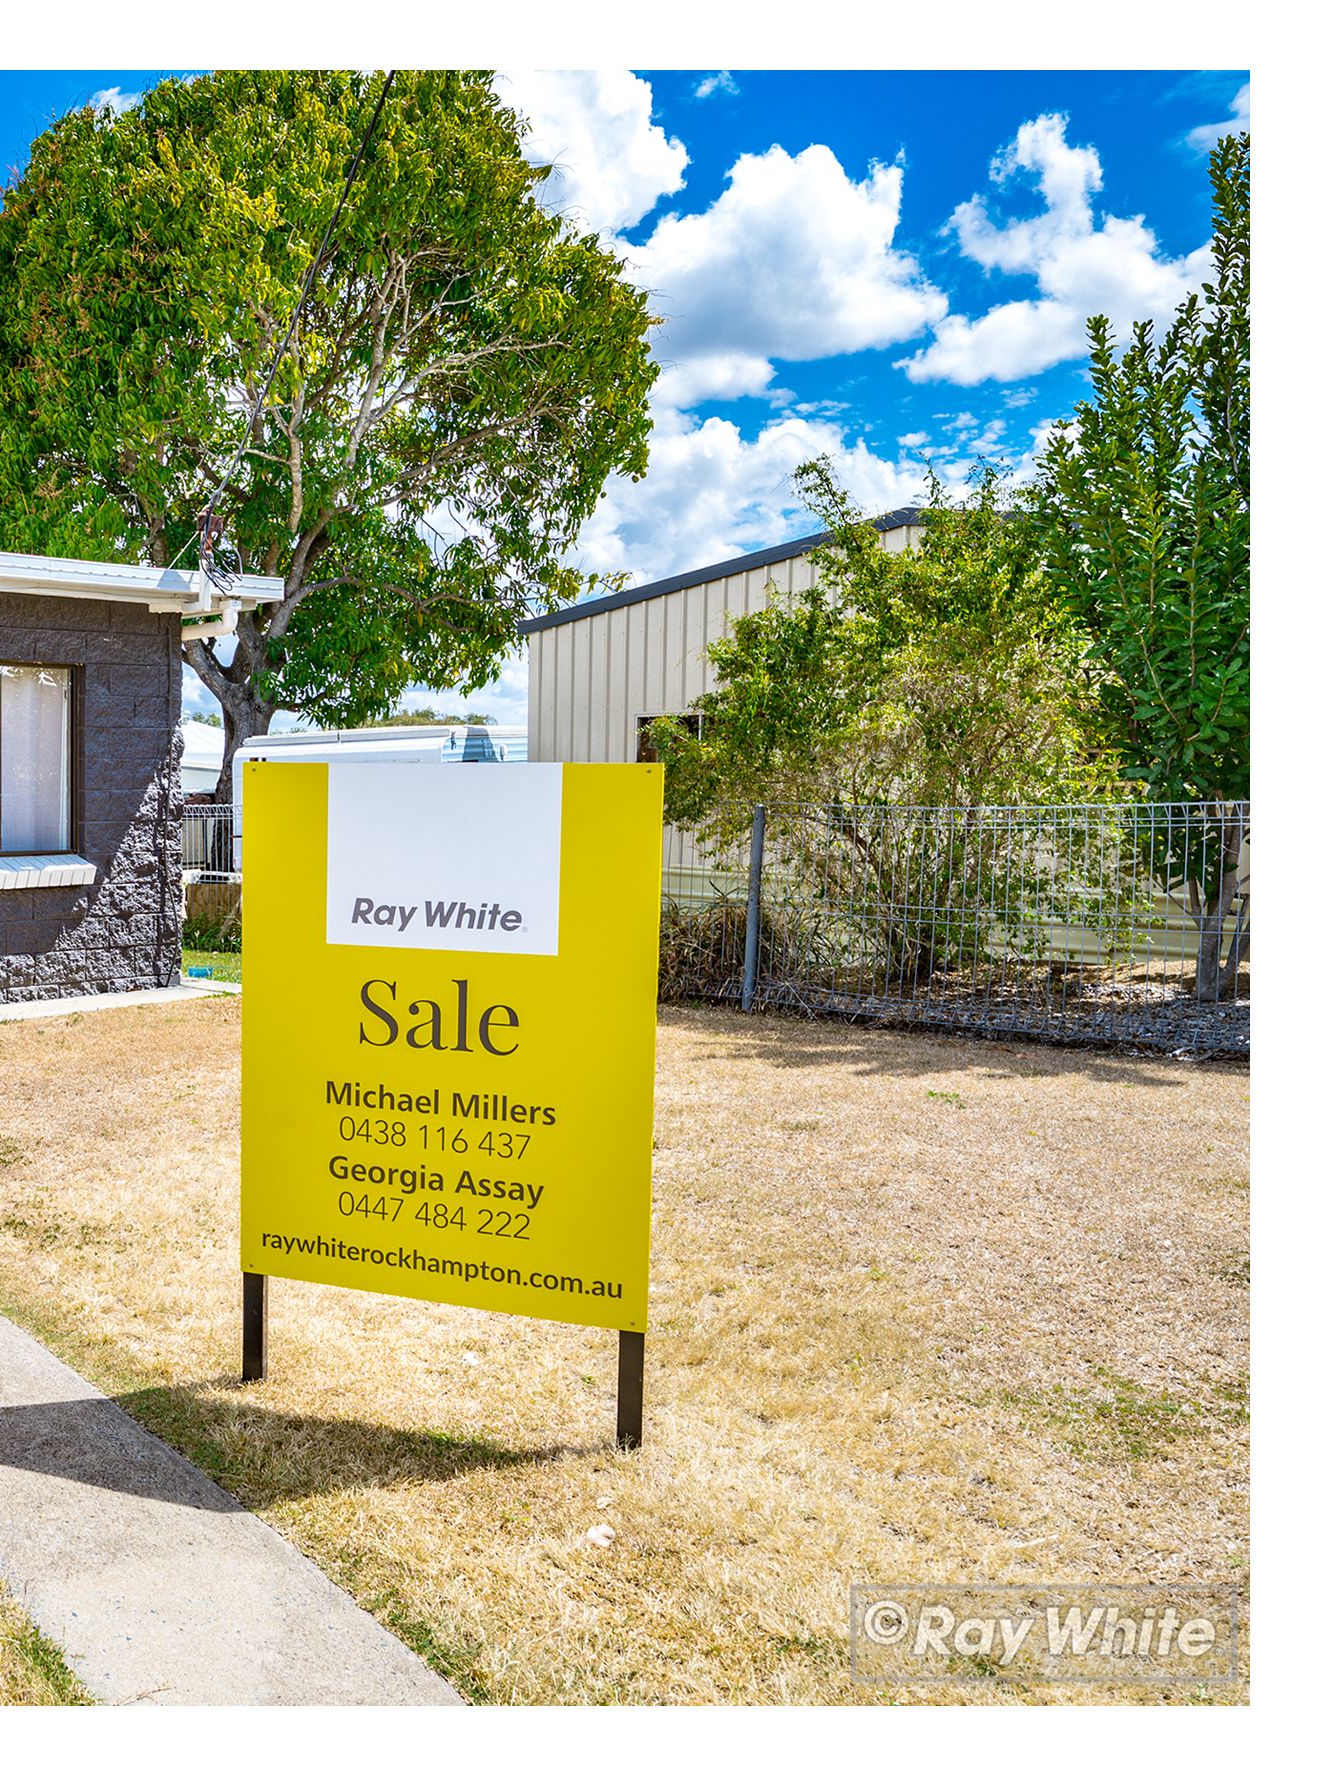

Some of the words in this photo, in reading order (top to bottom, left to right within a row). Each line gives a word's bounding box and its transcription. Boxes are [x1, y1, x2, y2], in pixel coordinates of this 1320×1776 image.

[352, 898, 418, 932] Ray
[425, 900, 522, 932] White
[359, 979, 520, 1056] Sale
[326, 1080, 439, 1115] Michael
[452, 1092, 556, 1126] Millers
[339, 1116, 407, 1147] 0438
[419, 1124, 469, 1154] 116
[478, 1131, 531, 1160] 437
[329, 1155, 444, 1195] Georgia
[454, 1171, 545, 1210] Assay
[338, 1191, 404, 1222] 0447
[414, 1201, 467, 1231] 484
[476, 1209, 530, 1240] 222
[262, 1231, 622, 1299] raywhiterockhampton.com.au
